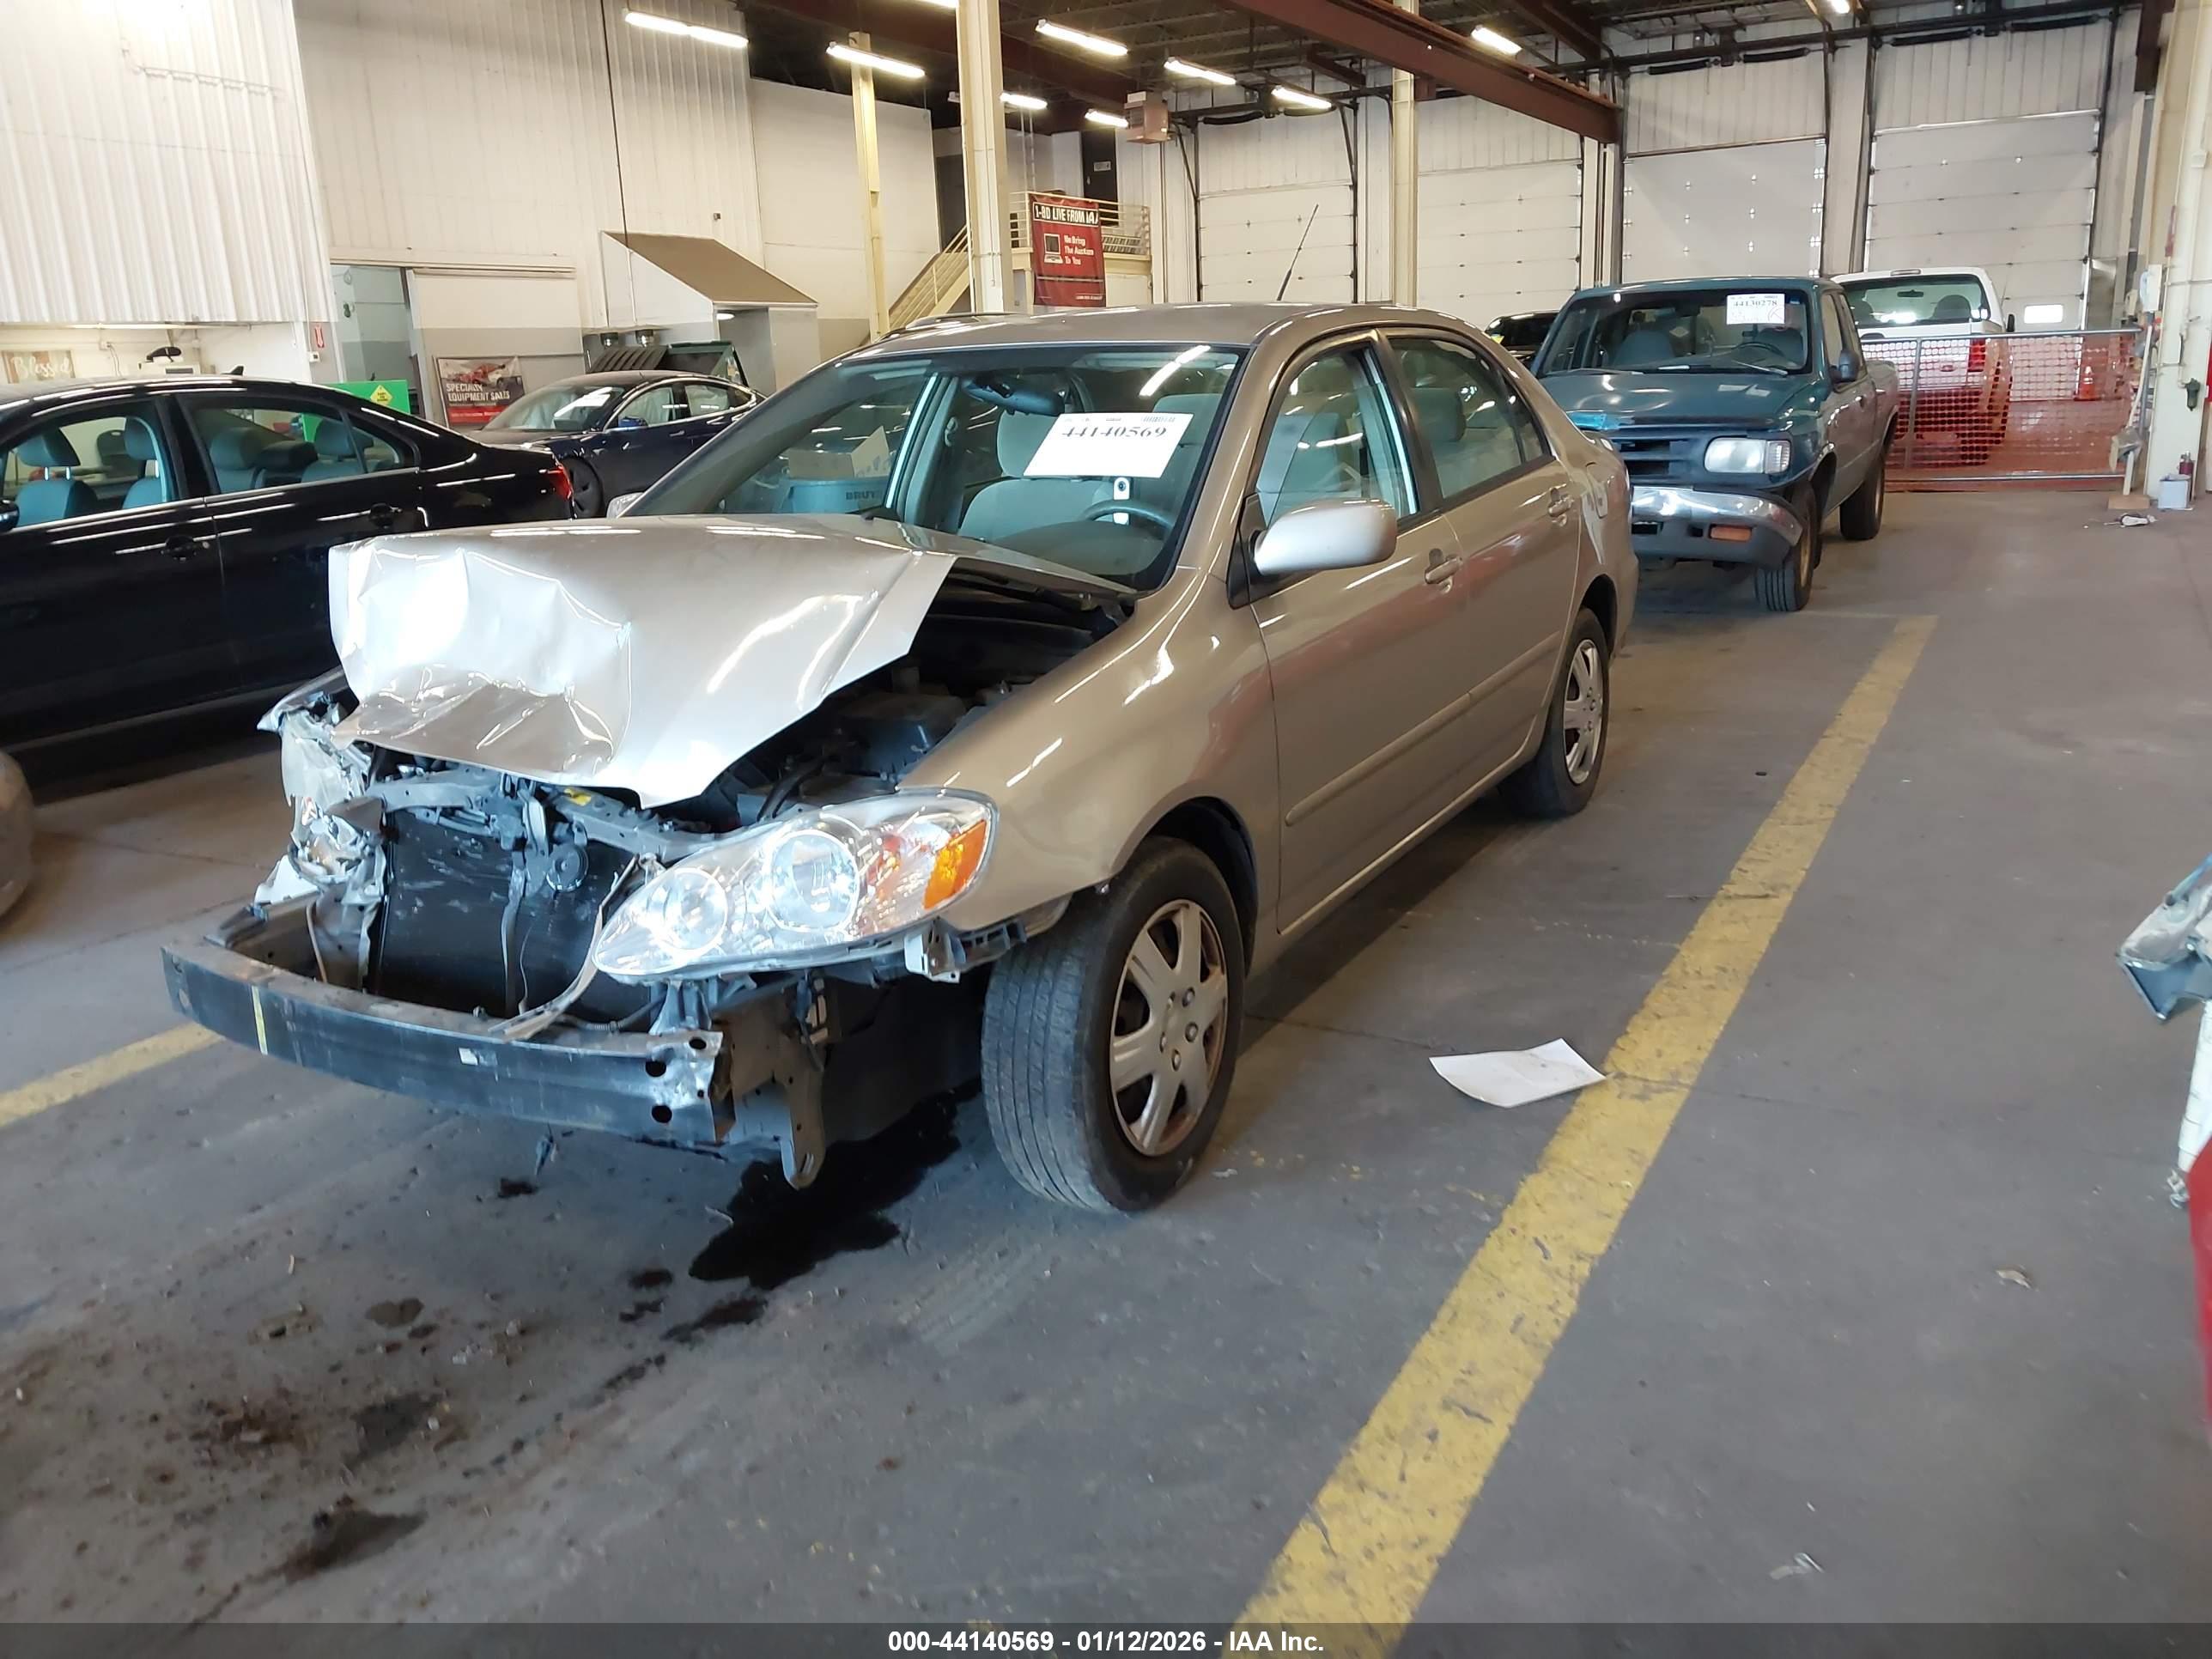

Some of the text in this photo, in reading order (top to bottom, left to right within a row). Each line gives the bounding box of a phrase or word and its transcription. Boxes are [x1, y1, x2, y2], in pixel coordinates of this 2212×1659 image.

[1053, 207, 1066, 221] LIVE
[1066, 210, 1085, 222] FROM
[1065, 246, 1094, 255] The Auction
[1065, 256, 1081, 264] To You
[447, 383, 483, 392] SPECIALTY
[448, 391, 510, 402] EQUIPMENT SALES
[1062, 427, 1167, 437] 44140569
